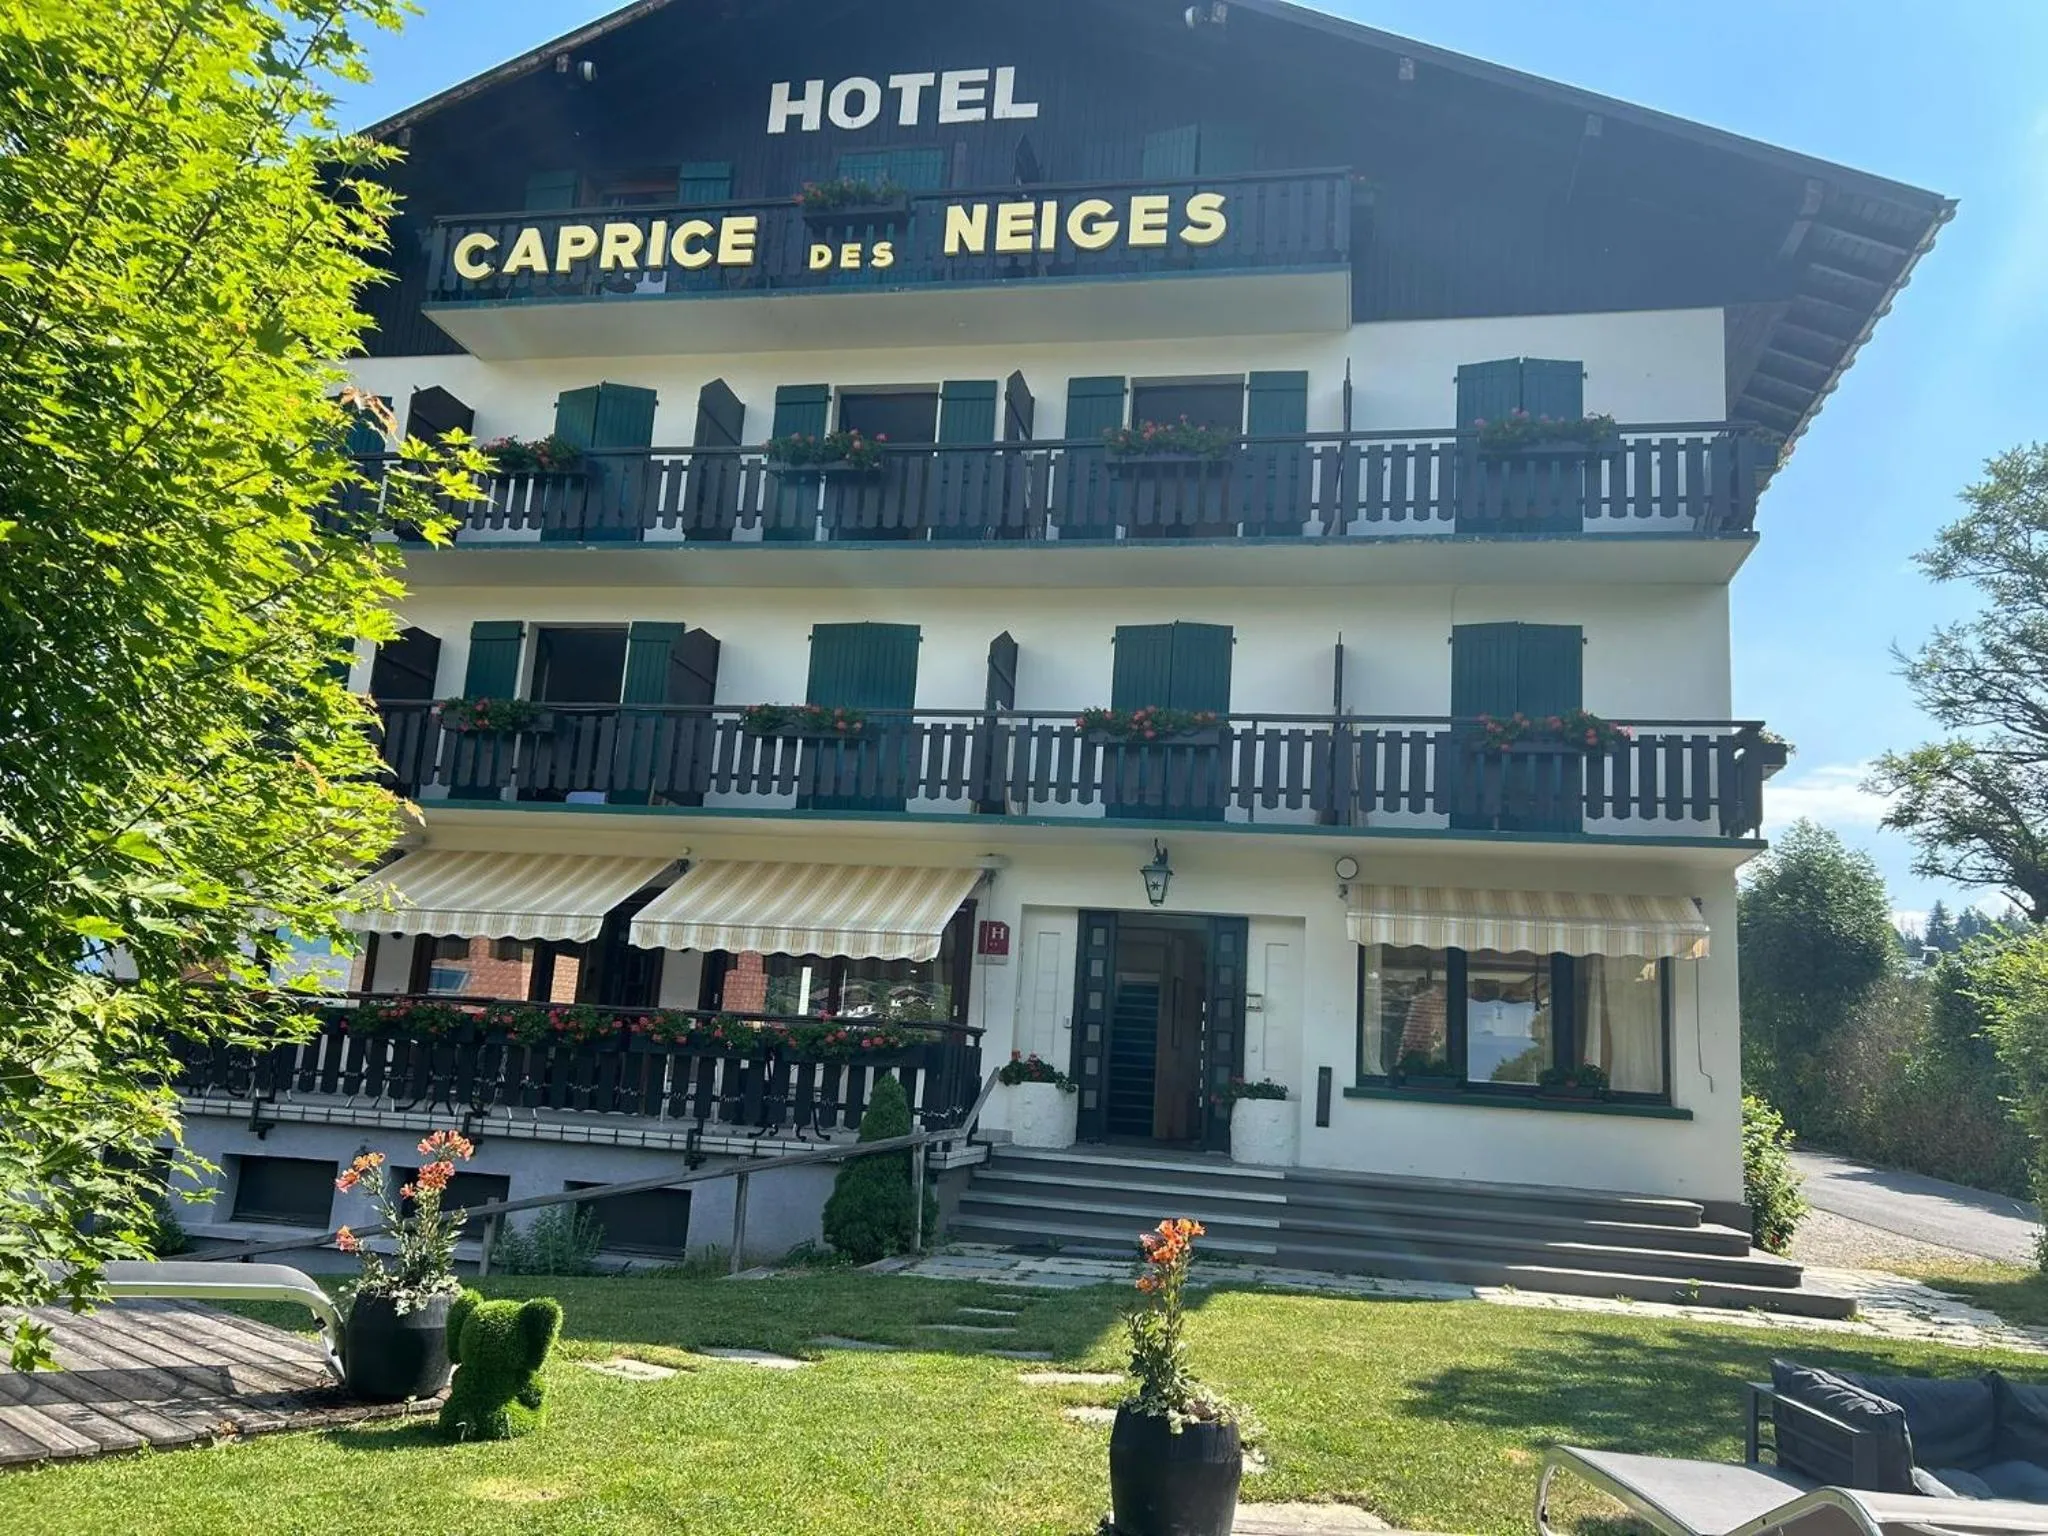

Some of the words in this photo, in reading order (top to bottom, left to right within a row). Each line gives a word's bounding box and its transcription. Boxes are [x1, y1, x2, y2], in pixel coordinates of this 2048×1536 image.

[767, 66, 1039, 134] HOTEL
[453, 215, 759, 281] CAPRICE
[809, 241, 895, 270] DES
[943, 192, 1228, 255] NEIGES
[992, 927, 1005, 940] H
